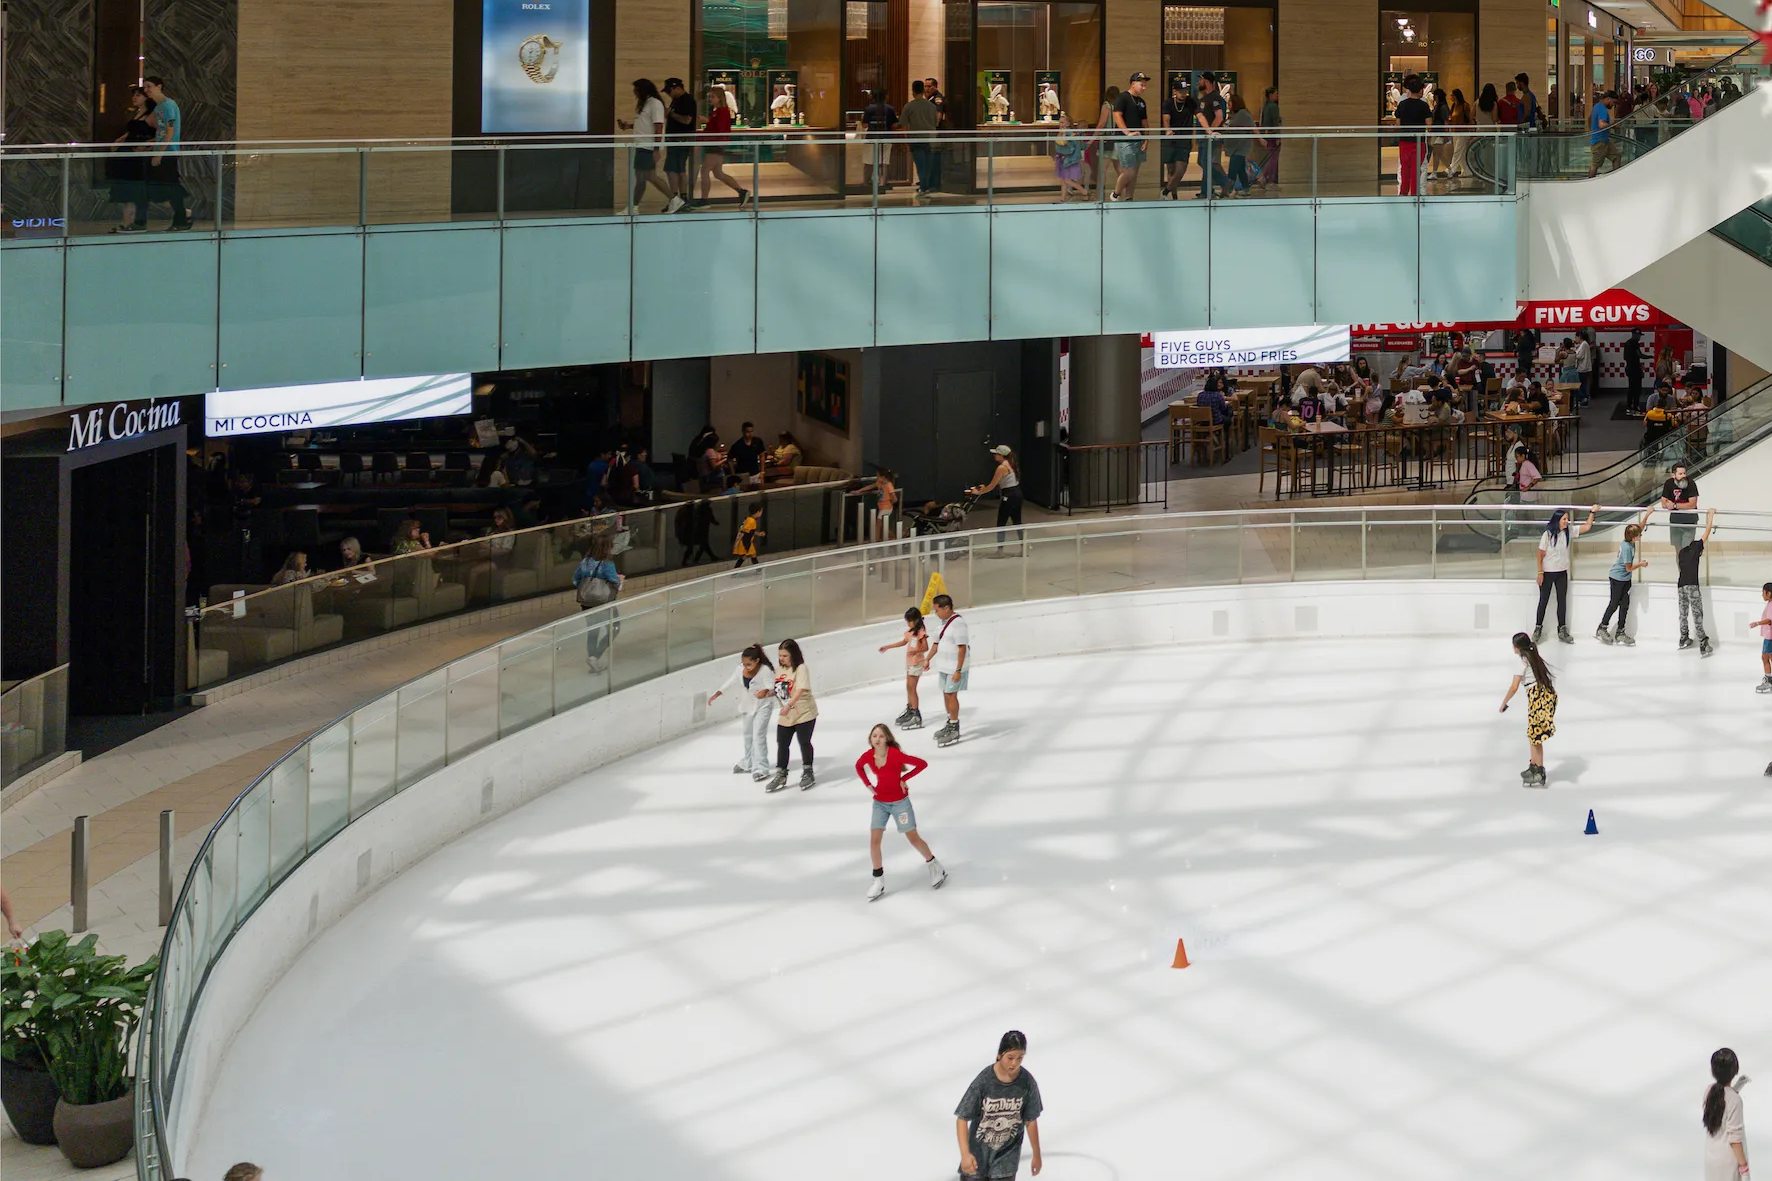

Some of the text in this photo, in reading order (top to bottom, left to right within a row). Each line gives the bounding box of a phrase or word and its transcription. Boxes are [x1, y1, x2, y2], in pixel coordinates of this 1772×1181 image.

[1535, 307, 1584, 324] FIVE
[1590, 304, 1650, 323] GUYS
[1161, 340, 1231, 352] FIVE GUYS
[1161, 350, 1298, 365] BURGERS AND FRIES
[1301, 405, 1315, 418] 10
[67, 398, 182, 452] Mi Cocina
[215, 412, 313, 432] MI COCINA
